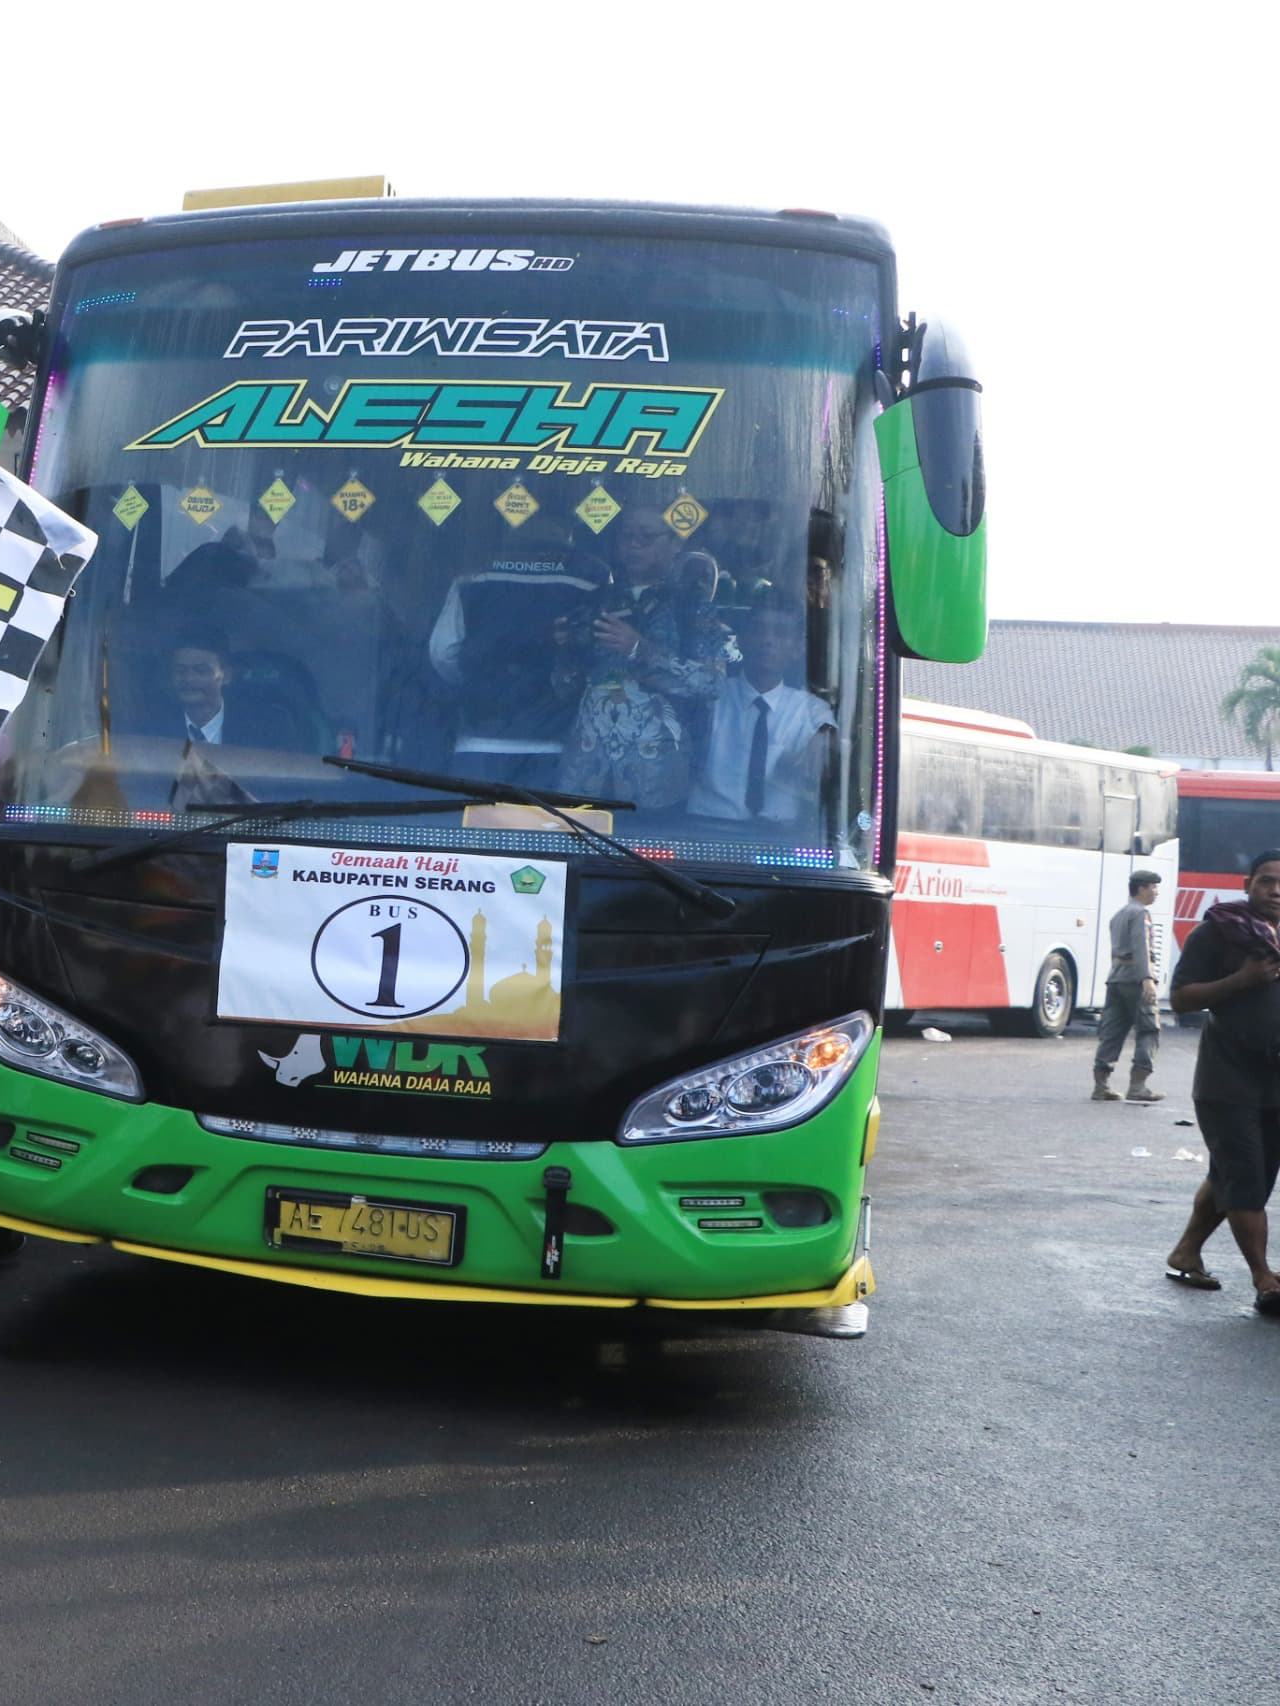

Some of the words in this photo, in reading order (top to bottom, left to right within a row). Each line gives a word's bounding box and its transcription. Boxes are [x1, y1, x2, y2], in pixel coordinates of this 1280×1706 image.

[312, 249, 536, 273] JETBUS
[528, 256, 576, 272] HD
[223, 317, 669, 363] PARIWISATA
[123, 378, 725, 459] ALESHA
[399, 452, 519, 471] Wahana
[525, 453, 607, 477] Djaja
[614, 457, 688, 478] Raja
[342, 499, 366, 511] 18+
[492, 560, 566, 572] INDONESIA
[331, 851, 409, 871] Jemaah
[414, 855, 459, 876] Haji
[292, 869, 408, 889] KABUPATEN
[414, 876, 496, 894] SERANG
[910, 867, 963, 898] Arion
[369, 904, 418, 920] BUS
[365, 922, 407, 1009] 1
[333, 1070, 402, 1089] WAHANA
[405, 1075, 450, 1093] DJAJA
[453, 1079, 492, 1096] RAJA
[289, 1201, 322, 1232] AE
[405, 1212, 440, 1242] US
